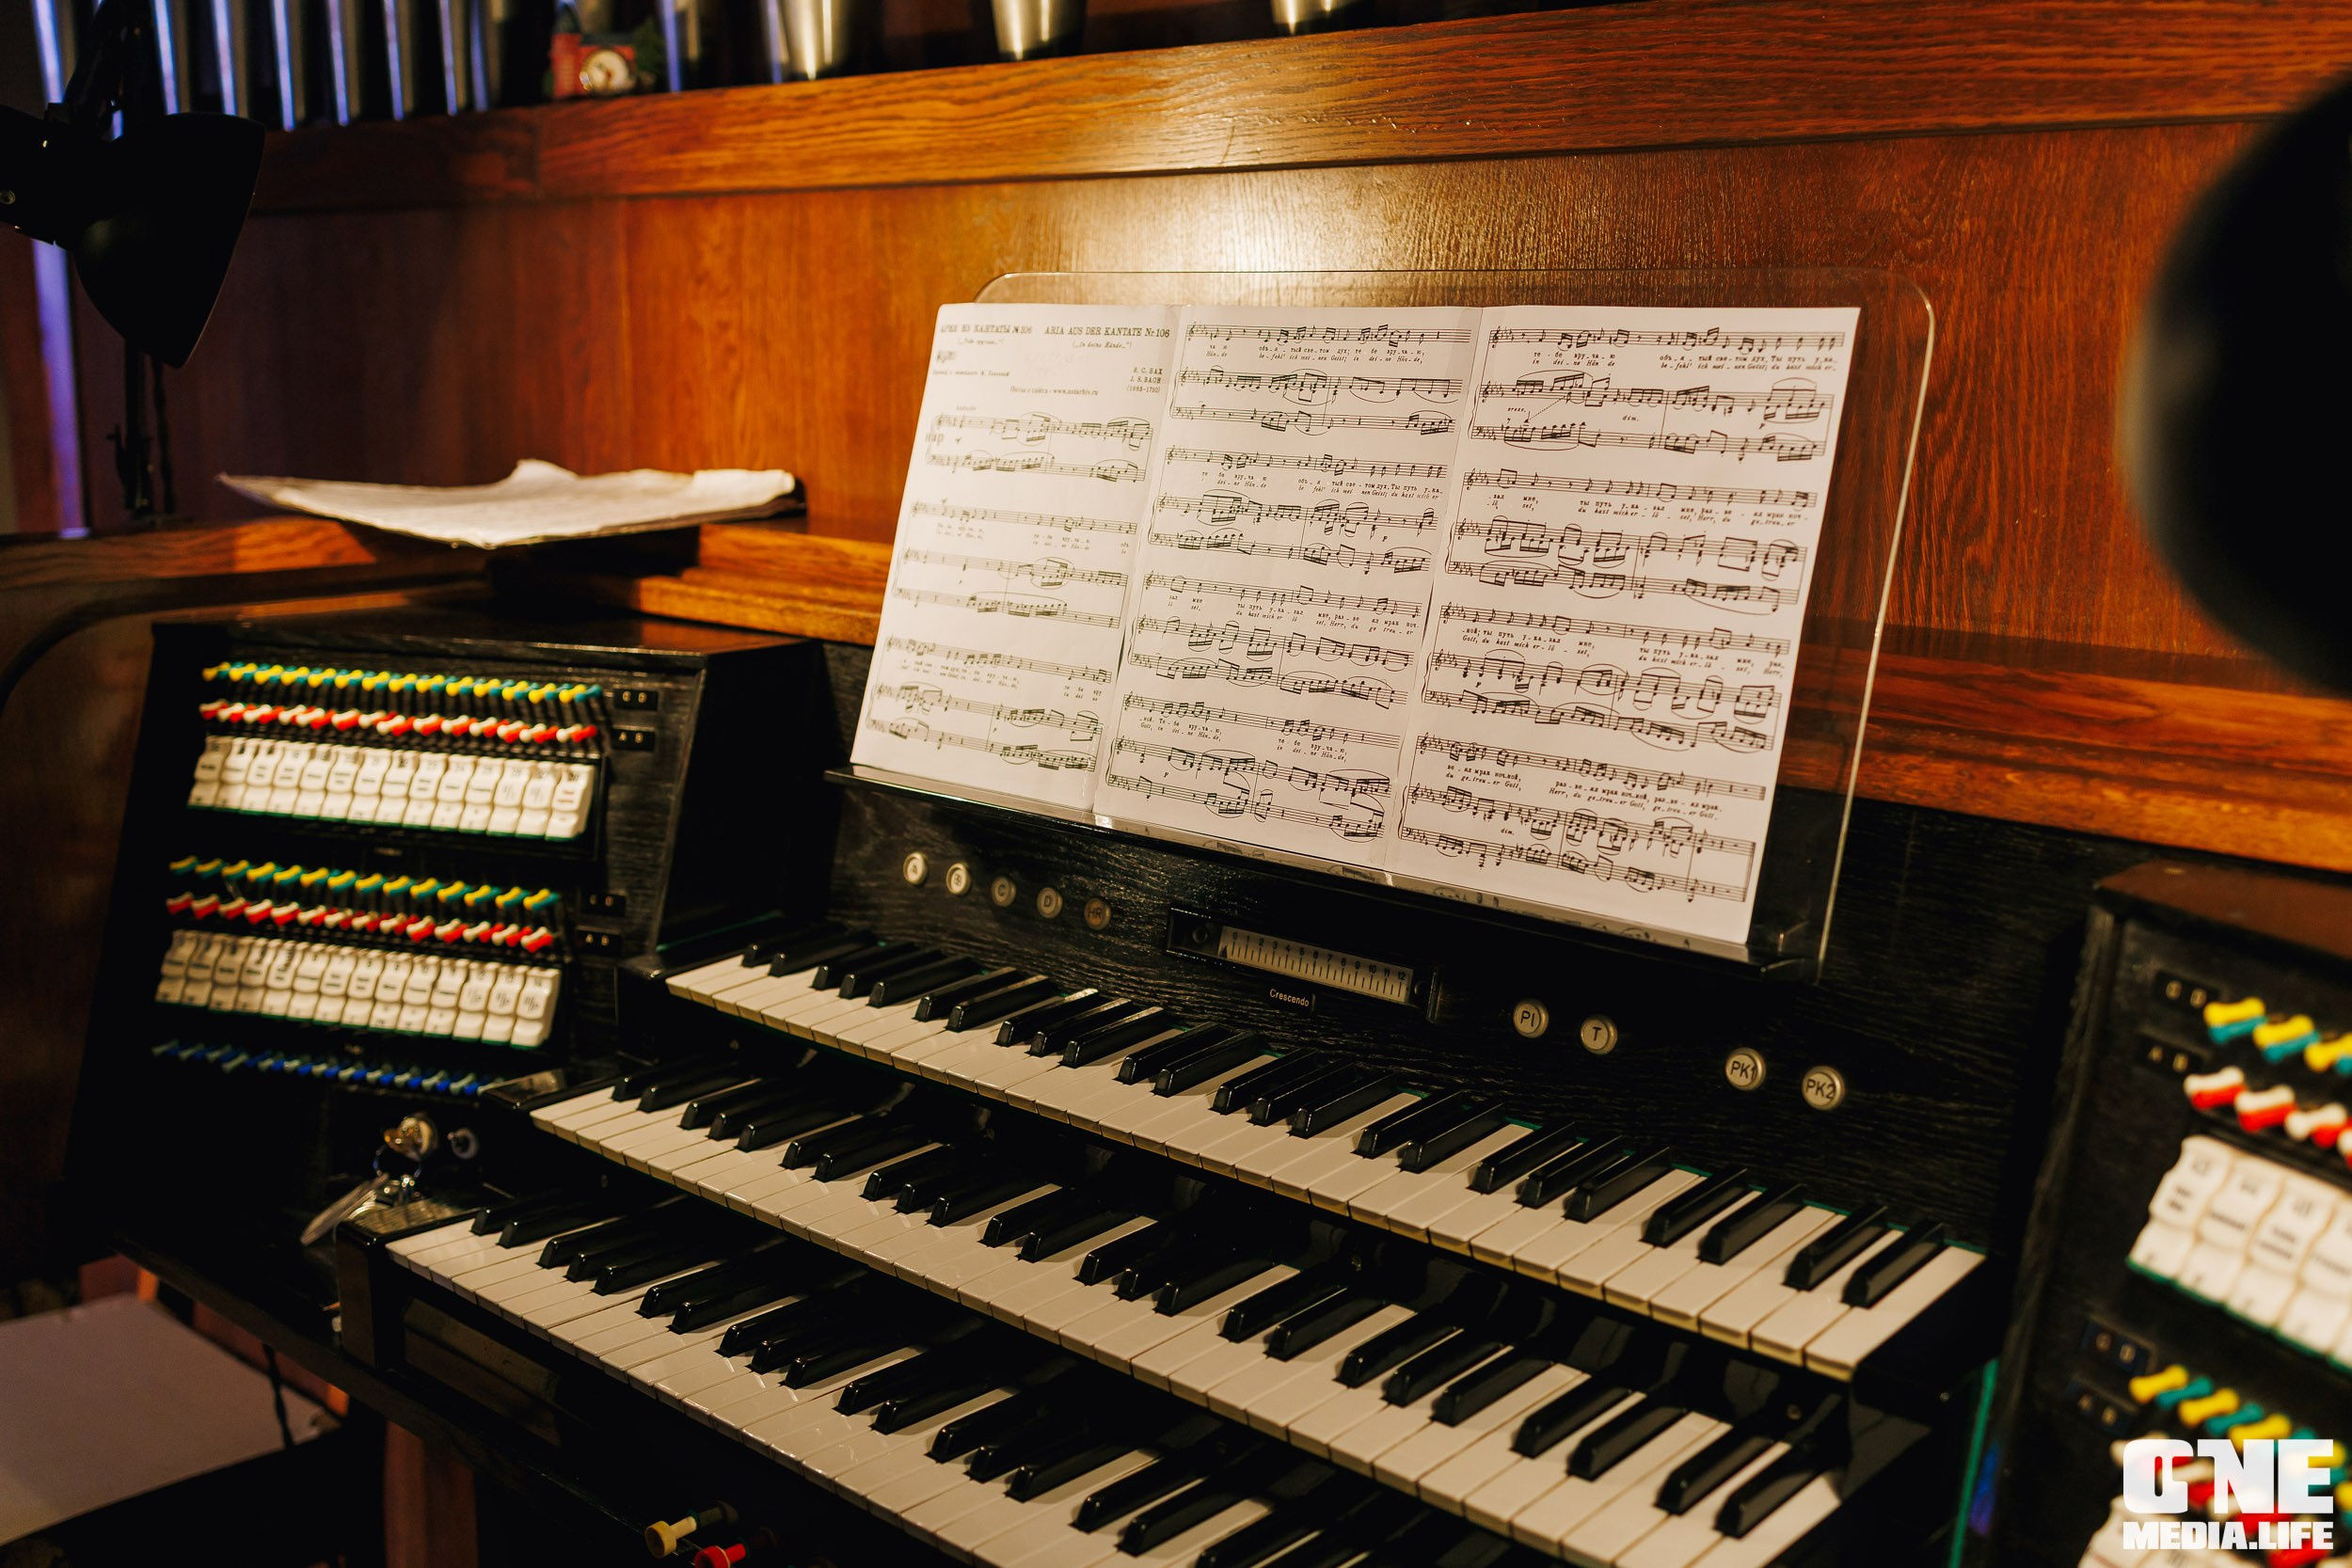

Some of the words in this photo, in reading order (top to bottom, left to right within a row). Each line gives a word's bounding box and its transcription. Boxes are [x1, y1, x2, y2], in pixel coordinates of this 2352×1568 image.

[1044, 326, 1064, 335] ARIA
[1068, 327, 1083, 335] AUS
[1085, 327, 1102, 336] DER
[1104, 327, 1142, 337] KANTATE
[1155, 329, 1170, 338] 106
[998, 885, 1005, 896] C
[1044, 895, 1050, 907] D
[1088, 909, 1102, 920] HR
[1258, 938, 1264, 946] 2
[1272, 941, 1278, 949] 3
[1285, 944, 1291, 952] 4
[1299, 947, 1305, 956] 5
[1341, 958, 1346, 966] 8
[1354, 961, 1360, 969] 9
[1368, 964, 1377, 974] 10
[1383, 969, 1391, 978] 11
[1397, 972, 1406, 981] 12
[1270, 988, 1310, 1007] Crescendo
[1592, 1026, 1601, 1041] T
[1731, 1061, 1756, 1081] PK1
[1806, 1079, 1836, 1100] PK2
